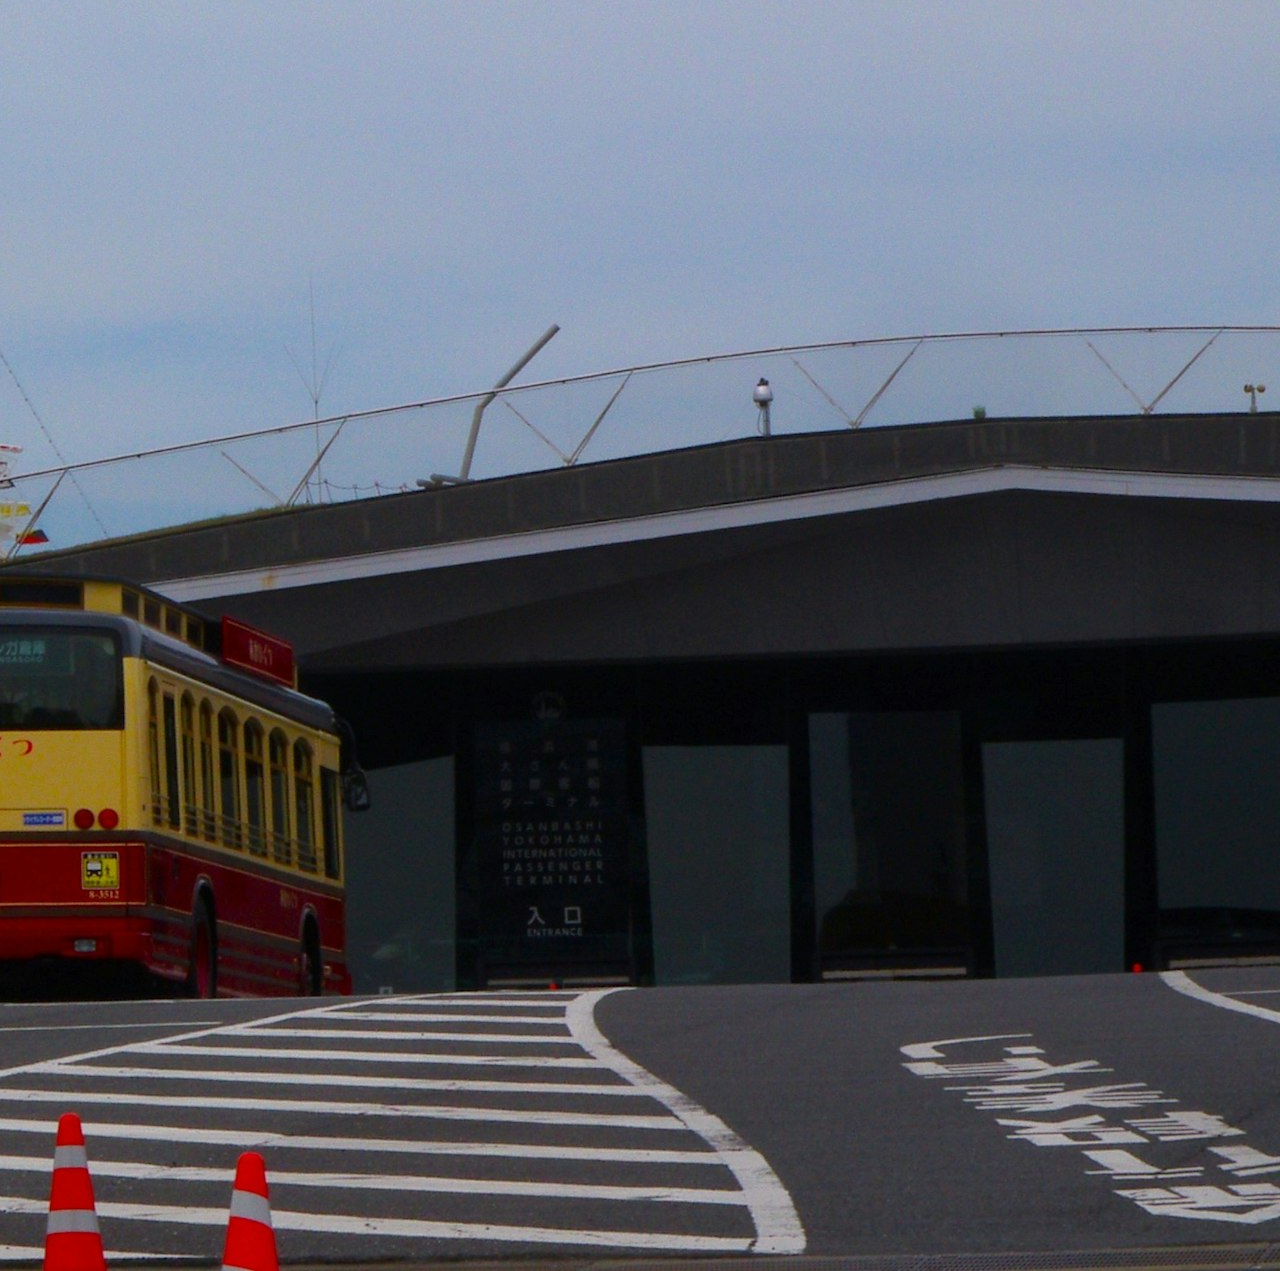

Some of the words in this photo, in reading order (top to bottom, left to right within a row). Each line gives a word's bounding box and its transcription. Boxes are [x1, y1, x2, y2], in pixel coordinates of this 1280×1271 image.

[502, 822, 603, 834] OSANBASHI
[502, 834, 603, 846] YOKOHAMA
[502, 847, 603, 859] INTERNATIONAL
[503, 860, 604, 873] PASSENGER
[503, 874, 605, 887] TERMINAL
[89, 890, 120, 899] 8-3512
[527, 906, 582, 925] 入口
[526, 927, 584, 937] ENTRANCE
